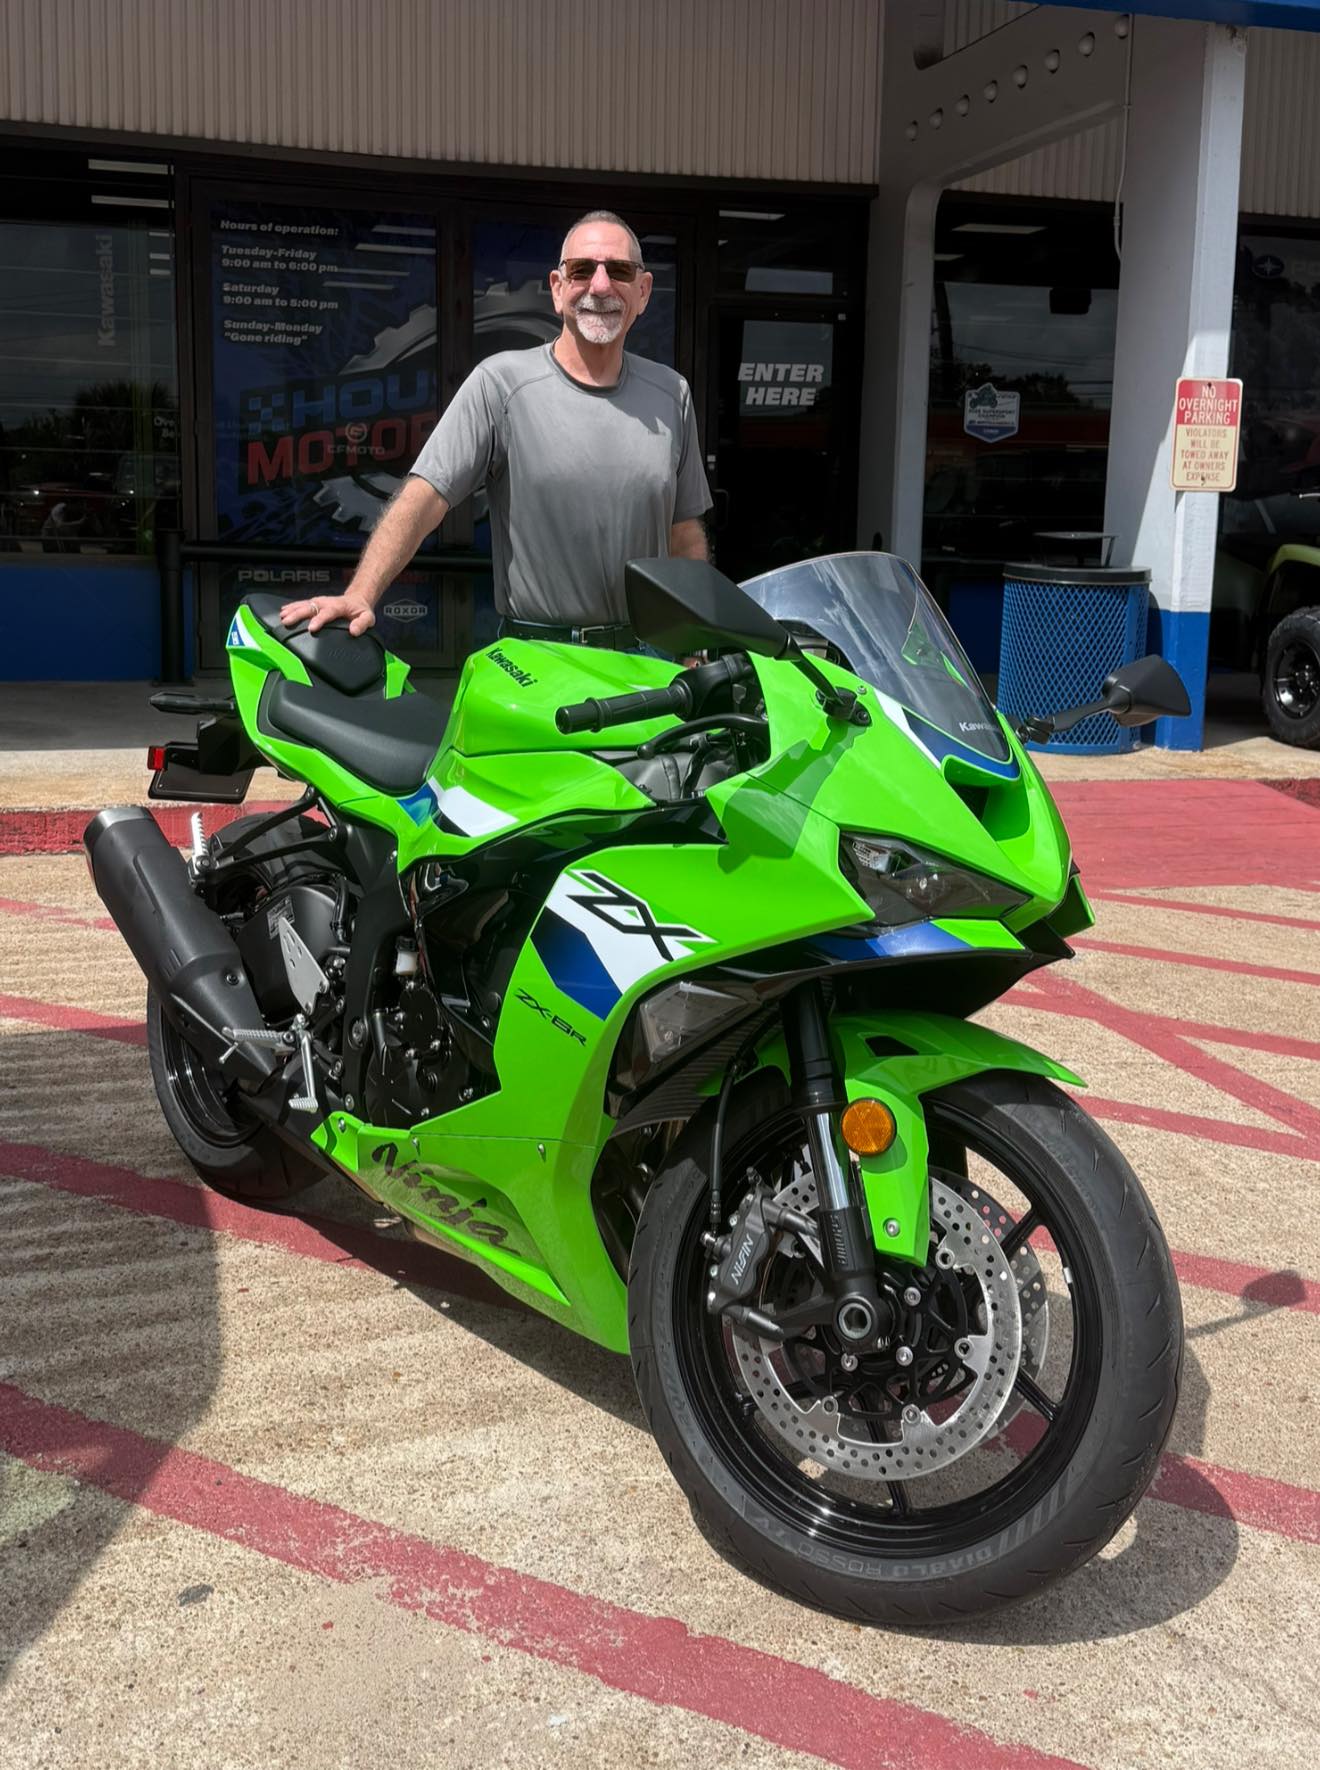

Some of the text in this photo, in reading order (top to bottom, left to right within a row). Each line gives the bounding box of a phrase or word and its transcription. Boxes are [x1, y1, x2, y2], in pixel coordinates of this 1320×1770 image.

[220, 220, 339, 236] Hours of operation:
[221, 245, 317, 261] Tuesday-Friday
[221, 258, 338, 274] 9:00 am to 6:00 pm
[96, 234, 115, 346] Kawasaki
[222, 283, 279, 296] Saturday
[223, 295, 251, 305] 9:00
[253, 299, 272, 307] am
[274, 298, 288, 307] to
[319, 301, 339, 311] pm
[224, 319, 322, 334] Sunday-Monday
[737, 362, 824, 383] ENTER
[745, 387, 817, 406] HERE
[1202, 385, 1216, 398] NO
[1179, 398, 1238, 412] OVERNIGHT
[1184, 411, 1231, 425] PARKING
[1185, 427, 1228, 438] VIOLATORS
[327, 444, 386, 455] CFMOTO
[1190, 439, 1220, 449] WILL BE
[1181, 449, 1229, 460] TOWED AWAY
[1182, 461, 1225, 470] AT OWNERS
[238, 570, 330, 582] POLARIS
[386, 606, 426, 615] ROXOR
[485, 647, 538, 688] Kawasaki
[515, 987, 587, 1047] ZX-6R
[371, 1142, 521, 1258] Ninja
[796, 1540, 882, 1577] ROSSO
[893, 1546, 994, 1578] DIABLO
